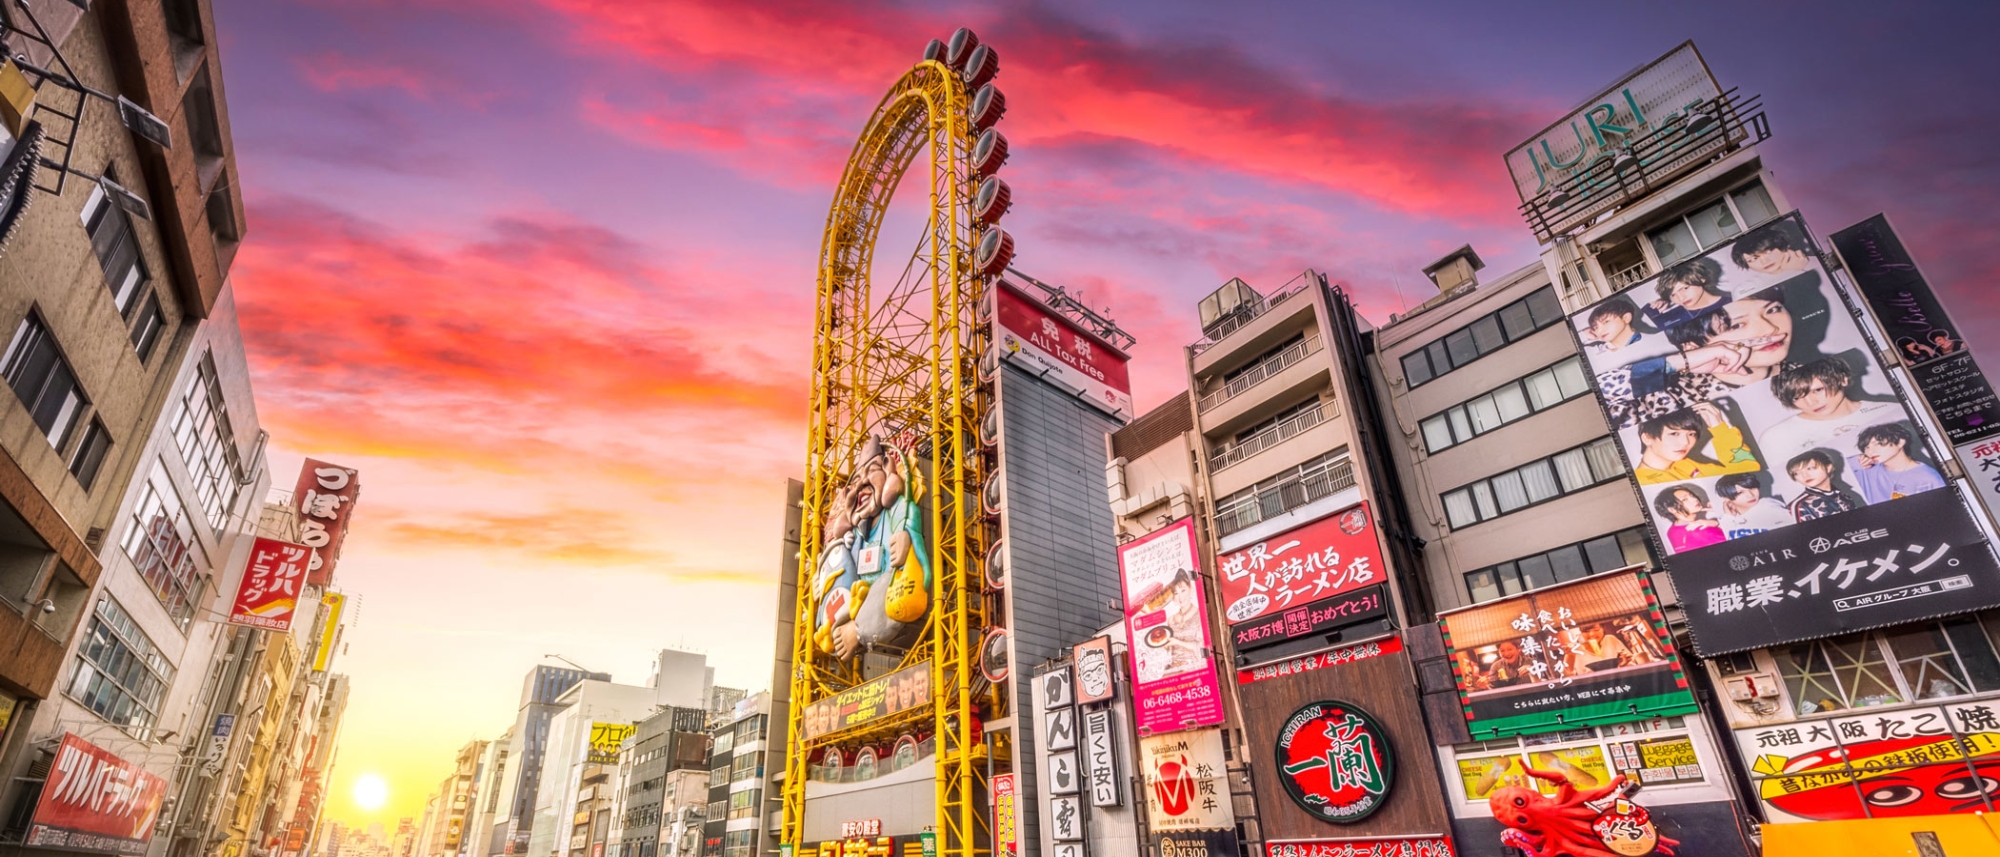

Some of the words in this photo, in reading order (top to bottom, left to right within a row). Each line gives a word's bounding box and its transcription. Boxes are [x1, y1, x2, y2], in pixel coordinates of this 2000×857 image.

[1526, 88, 1647, 195] JURI
[1042, 317, 1093, 361] 免税
[1022, 347, 1036, 360] Don
[1038, 355, 1063, 375] Quijote
[1030, 332, 1052, 354] ALL
[1055, 344, 1077, 367] Tax
[1080, 361, 1105, 381] Free
[1926, 367, 1968, 384] セットサロン
[1934, 386, 1984, 405] フォトスタジオ
[1945, 383, 1966, 394] エステ
[1945, 402, 1992, 420] こちらまで
[1947, 428, 1963, 436] TEL
[1832, 528, 1889, 548] AGE
[1131, 543, 1182, 568] マダムシンコ
[1222, 540, 1301, 582] 世界一
[1753, 549, 1797, 567] AIR
[244, 550, 278, 603] ドラッグ
[269, 546, 305, 596] ツルハ
[1132, 559, 1186, 584] マダムブリュレ
[1246, 546, 1340, 596] 人が訪れる
[1275, 557, 1374, 608] ラーメン店
[1856, 597, 1873, 606] AIR
[1875, 591, 1908, 602] グループ
[1911, 585, 1932, 595] 大阪
[1286, 610, 1308, 624] 開催
[1288, 621, 1310, 634] 決定
[1237, 620, 1285, 645] 大阪万博
[1558, 606, 1584, 655] おいしく
[1537, 610, 1572, 687] 食べたいから
[1143, 685, 1211, 709] 06-6468-4538
[217, 715, 233, 735] 焼肉
[1281, 706, 1322, 748] ICHIRAN
[1618, 725, 1629, 735] 2
[1652, 720, 1662, 731] F
[1089, 714, 1112, 802] 旨くて安い
[1284, 714, 1384, 793] 一蘭
[1641, 741, 1692, 757] Luggage
[1648, 755, 1695, 768] Service
[52, 744, 147, 819] ツルハドラッグ
[1196, 762, 1219, 814] 松阪牛
[1191, 839, 1206, 847] BAR
[1609, 820, 1644, 841] くくる
